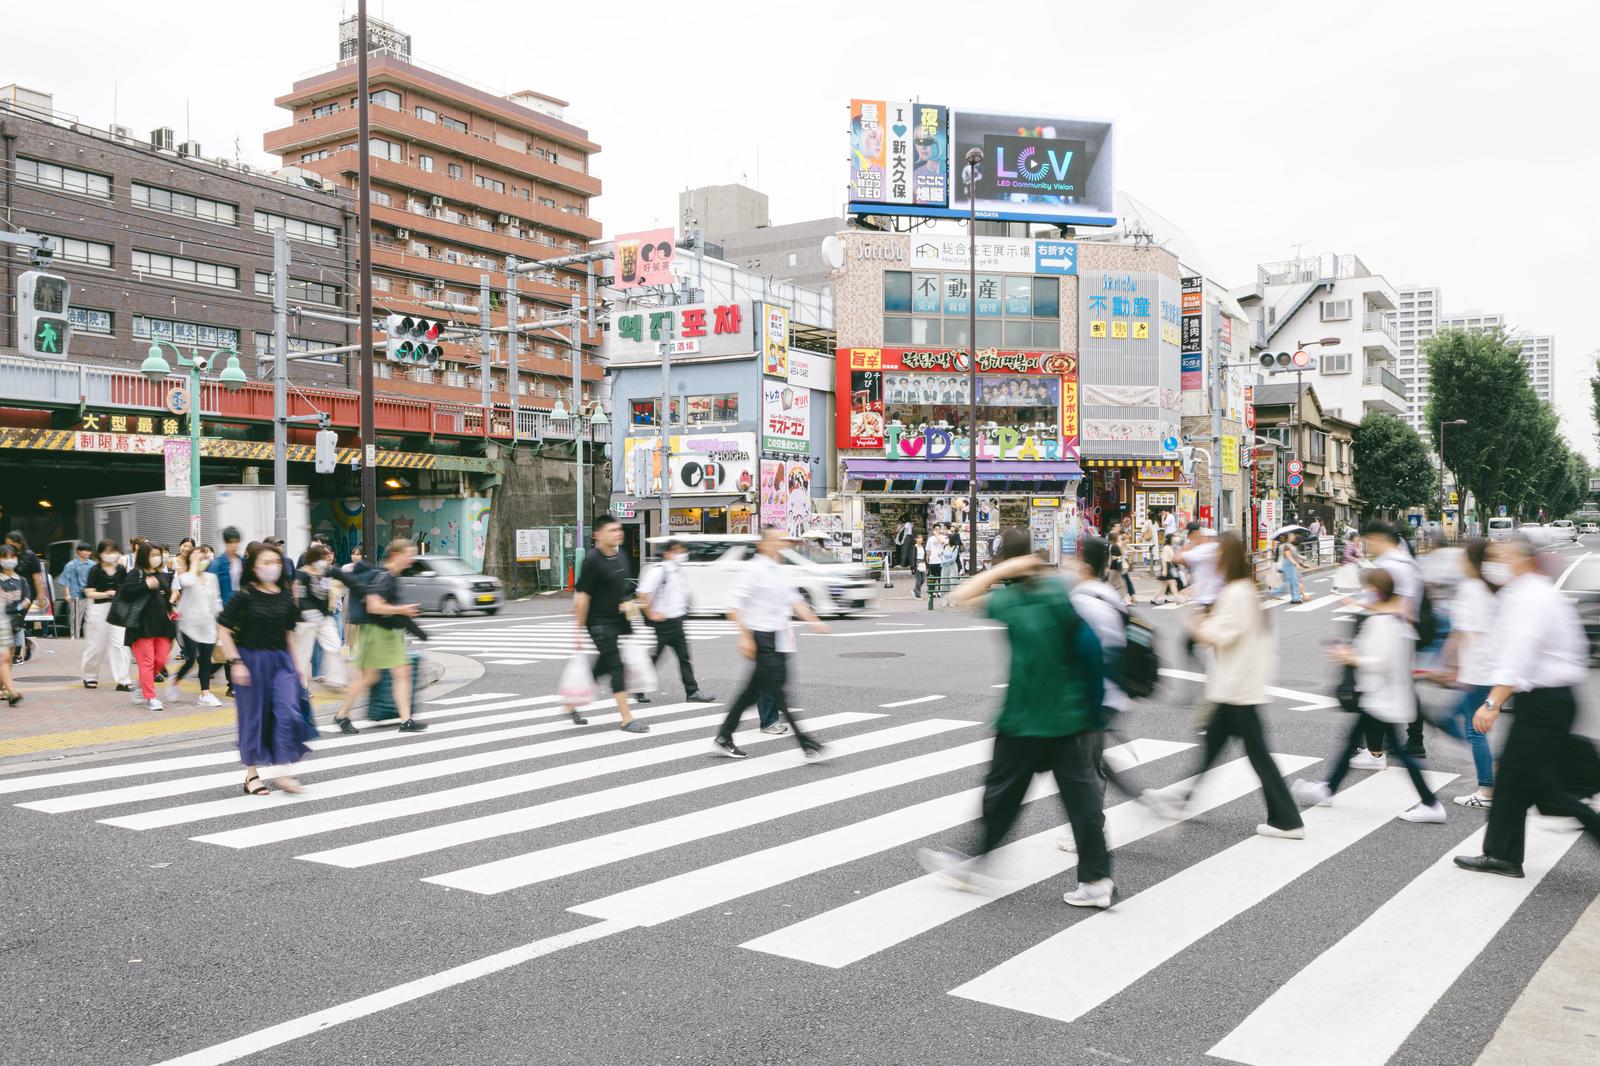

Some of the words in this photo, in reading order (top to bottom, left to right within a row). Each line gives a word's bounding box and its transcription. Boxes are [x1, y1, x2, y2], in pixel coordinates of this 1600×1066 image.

[896, 109, 903, 121] I
[892, 140, 906, 198] 新大久保
[1012, 181, 1051, 191] Community
[1038, 246, 1073, 256] 右折すぐ
[916, 276, 998, 299] 不動産
[1088, 295, 1152, 317] 不動産
[765, 390, 780, 400] トレカ
[1066, 383, 1075, 434] トッポッキ
[83, 413, 202, 434] 大型最徐
[995, 426, 1080, 460] PARK
